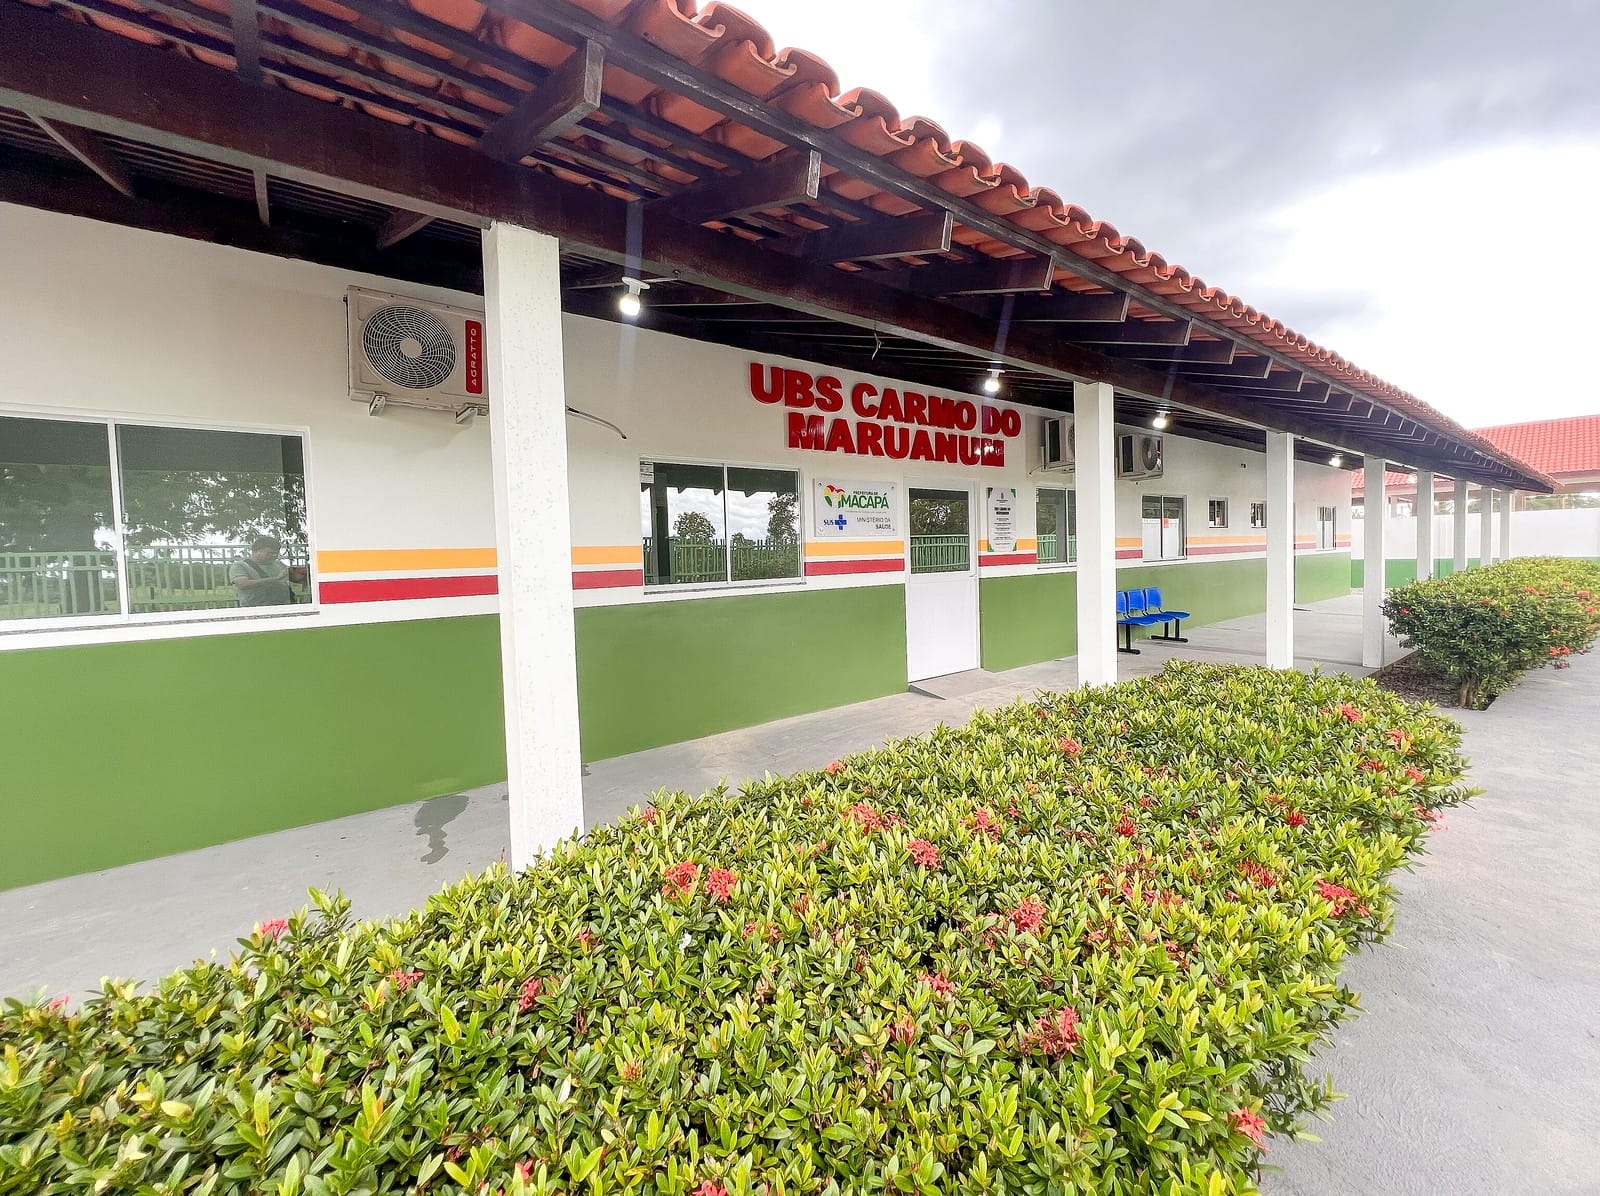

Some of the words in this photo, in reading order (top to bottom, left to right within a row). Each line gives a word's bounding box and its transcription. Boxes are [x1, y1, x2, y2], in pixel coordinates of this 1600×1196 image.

[750, 362, 844, 413] UBS
[851, 383, 977, 432] CARMO
[981, 405, 1022, 438] DO
[788, 411, 1005, 468] MARUANUM
[841, 493, 889, 509] MACAPÁ
